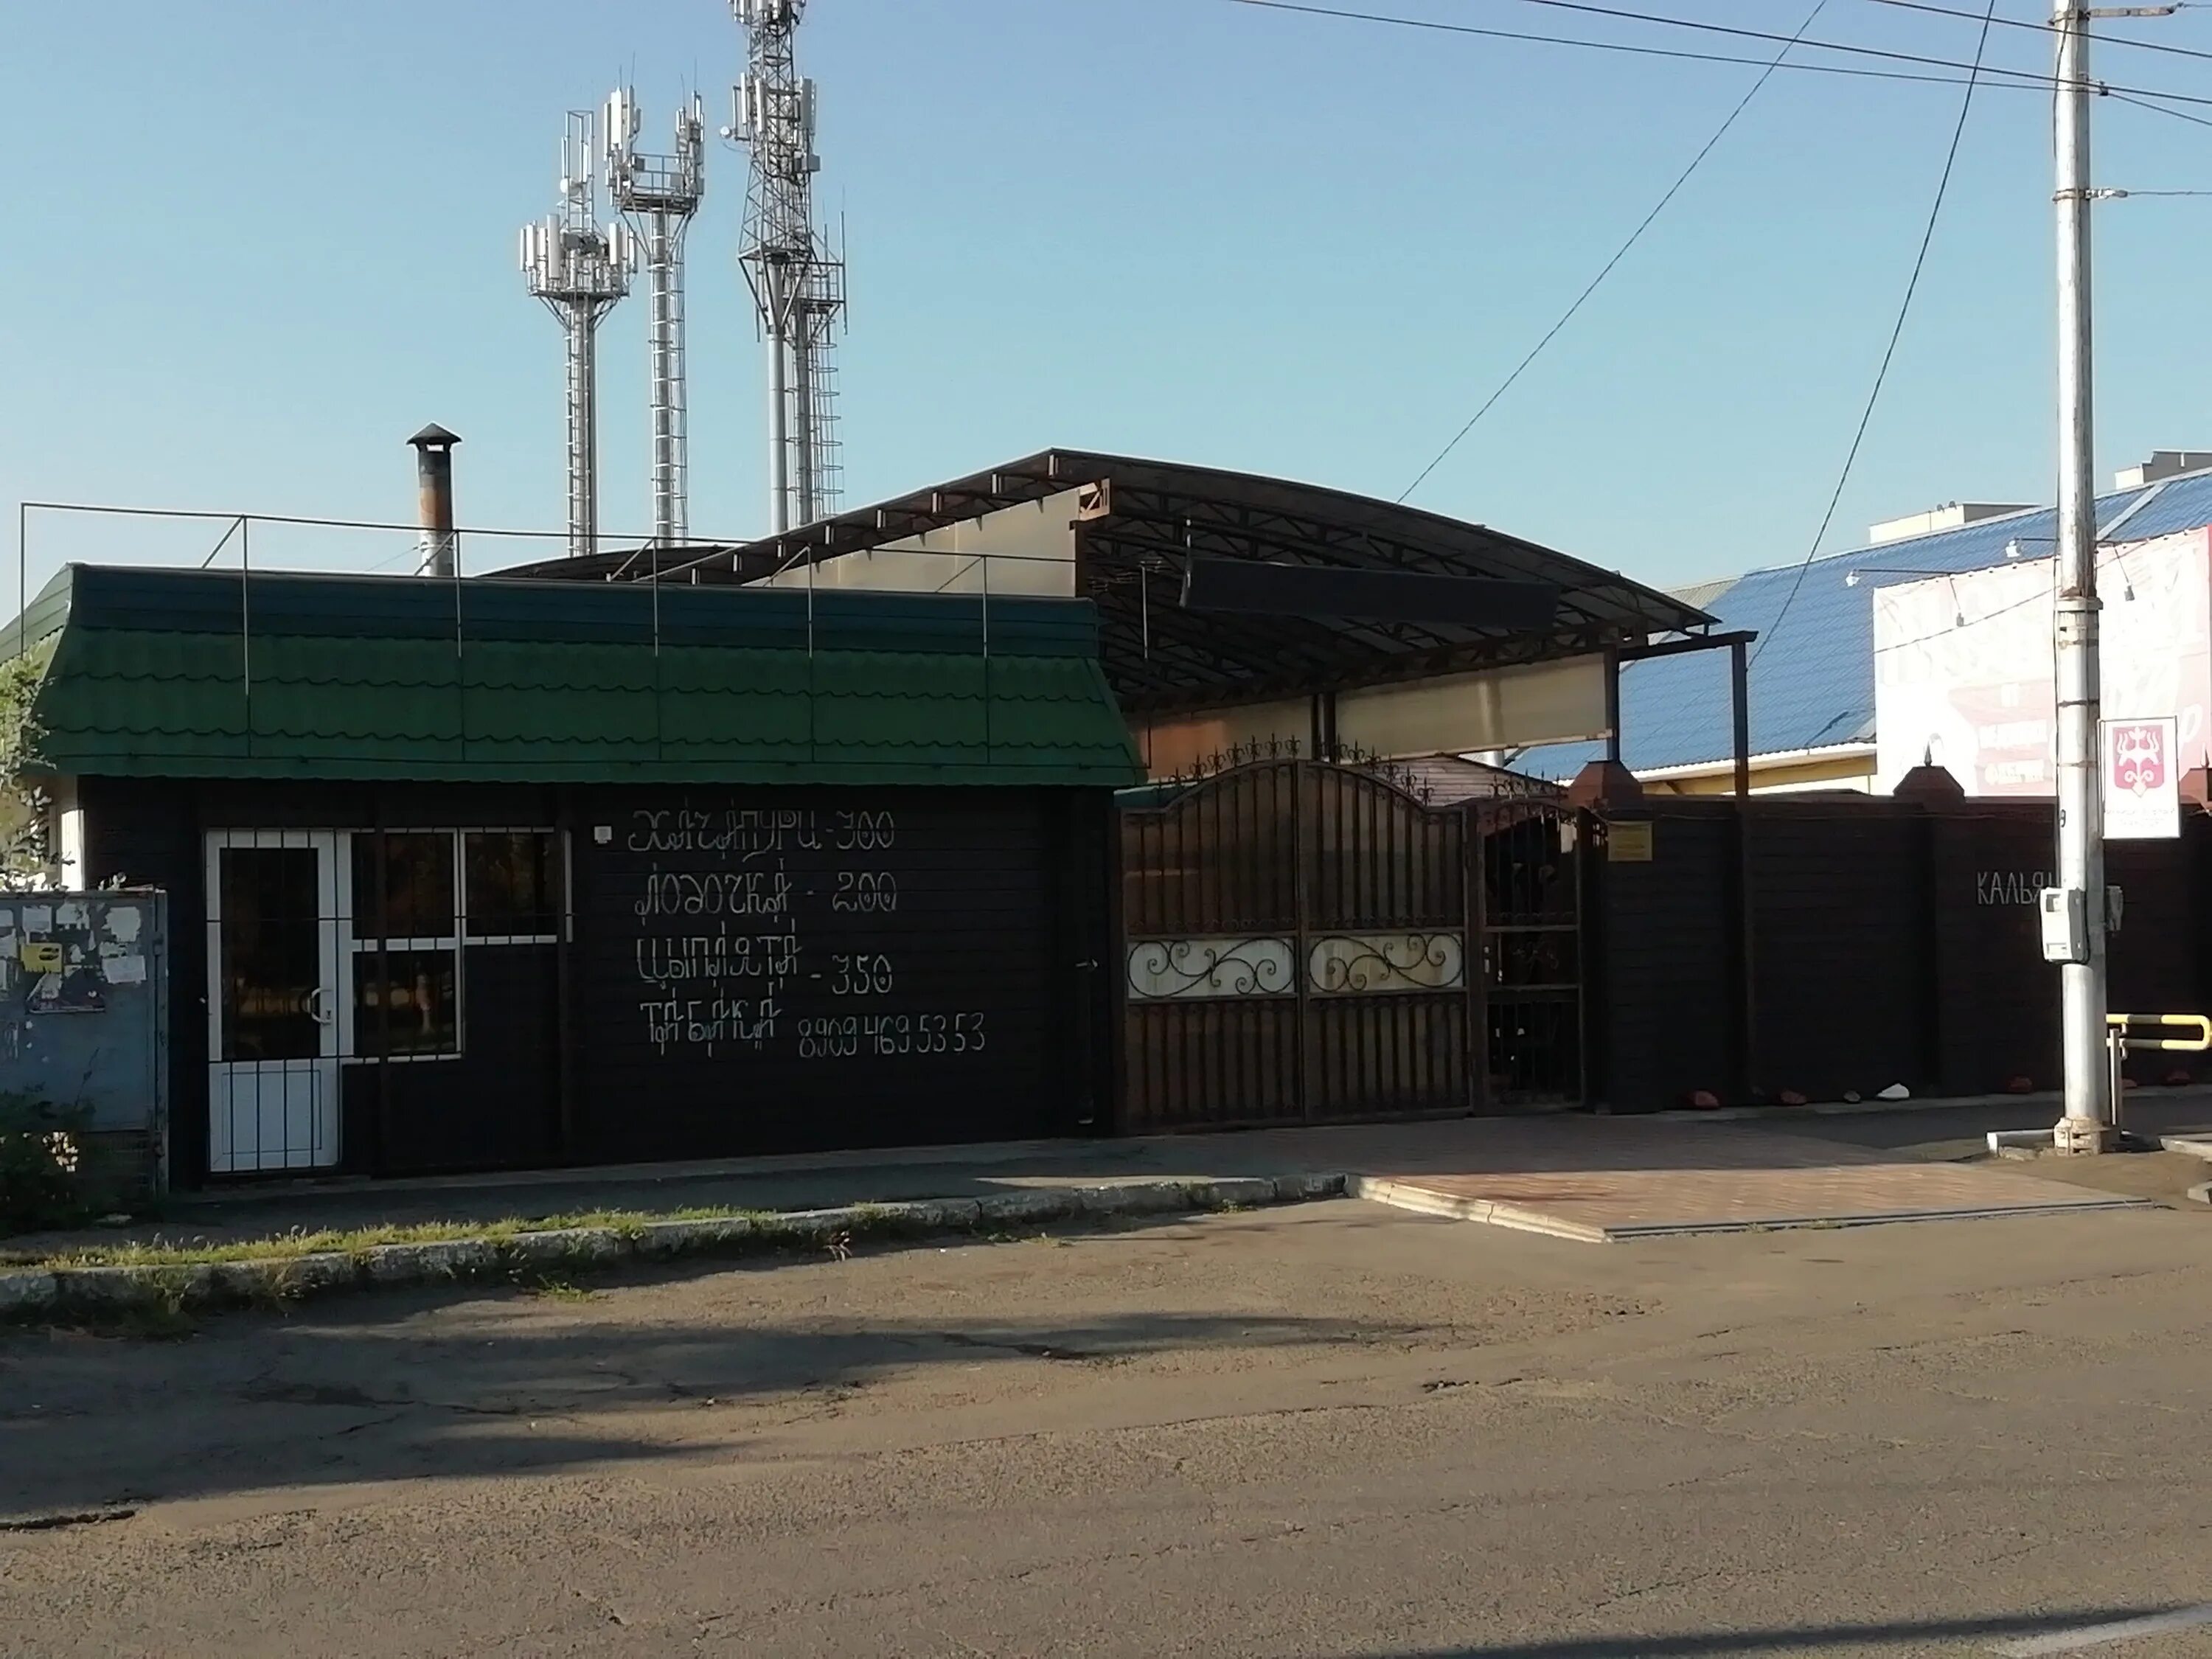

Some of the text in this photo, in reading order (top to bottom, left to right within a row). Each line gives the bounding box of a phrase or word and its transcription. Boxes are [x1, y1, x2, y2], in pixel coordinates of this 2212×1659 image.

[832, 872, 897, 913] 200
[636, 918, 802, 990] ЦЫПЛЯТА
[832, 954, 893, 995] 350
[639, 982, 782, 1057] ТАБАКА
